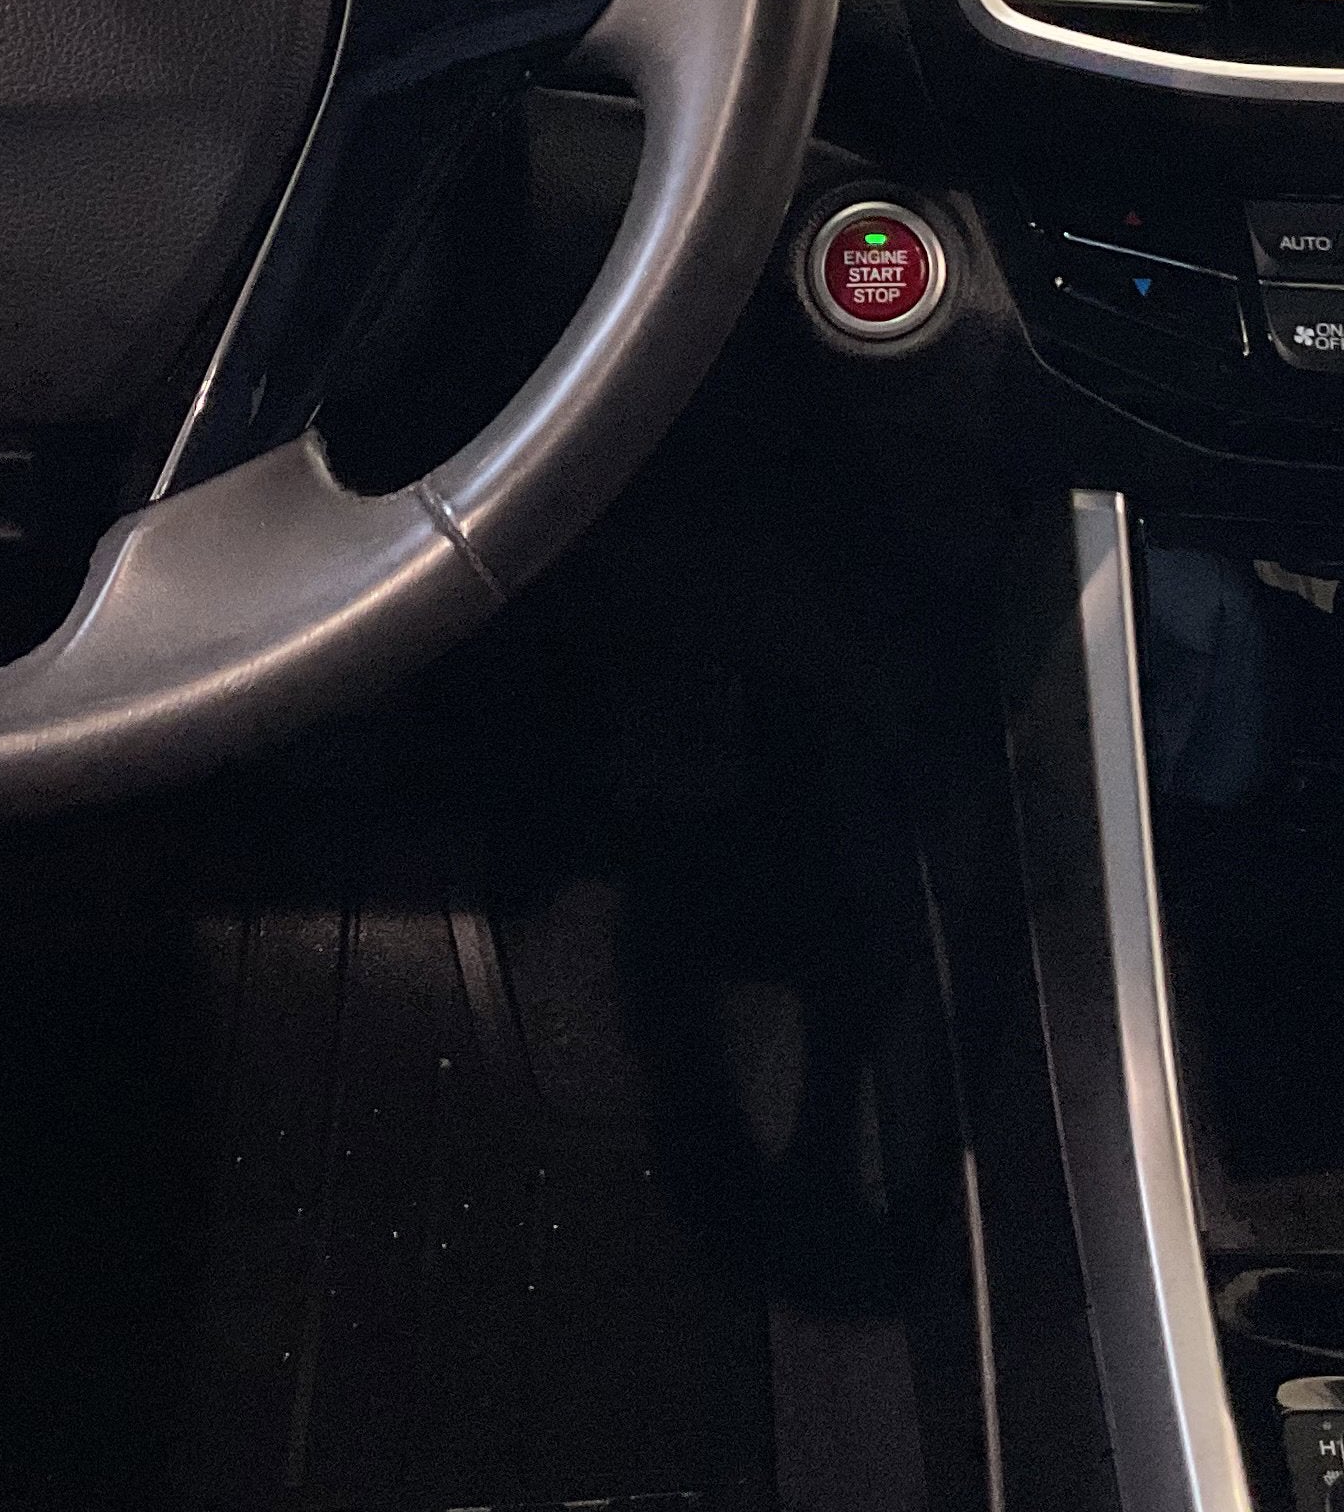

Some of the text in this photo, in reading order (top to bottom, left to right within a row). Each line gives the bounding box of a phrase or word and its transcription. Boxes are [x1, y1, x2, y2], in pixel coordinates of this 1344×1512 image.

[1280, 236, 1331, 251] AUTO
[844, 251, 907, 265] ENGINE
[849, 267, 904, 282] START
[853, 288, 900, 303] STOP
